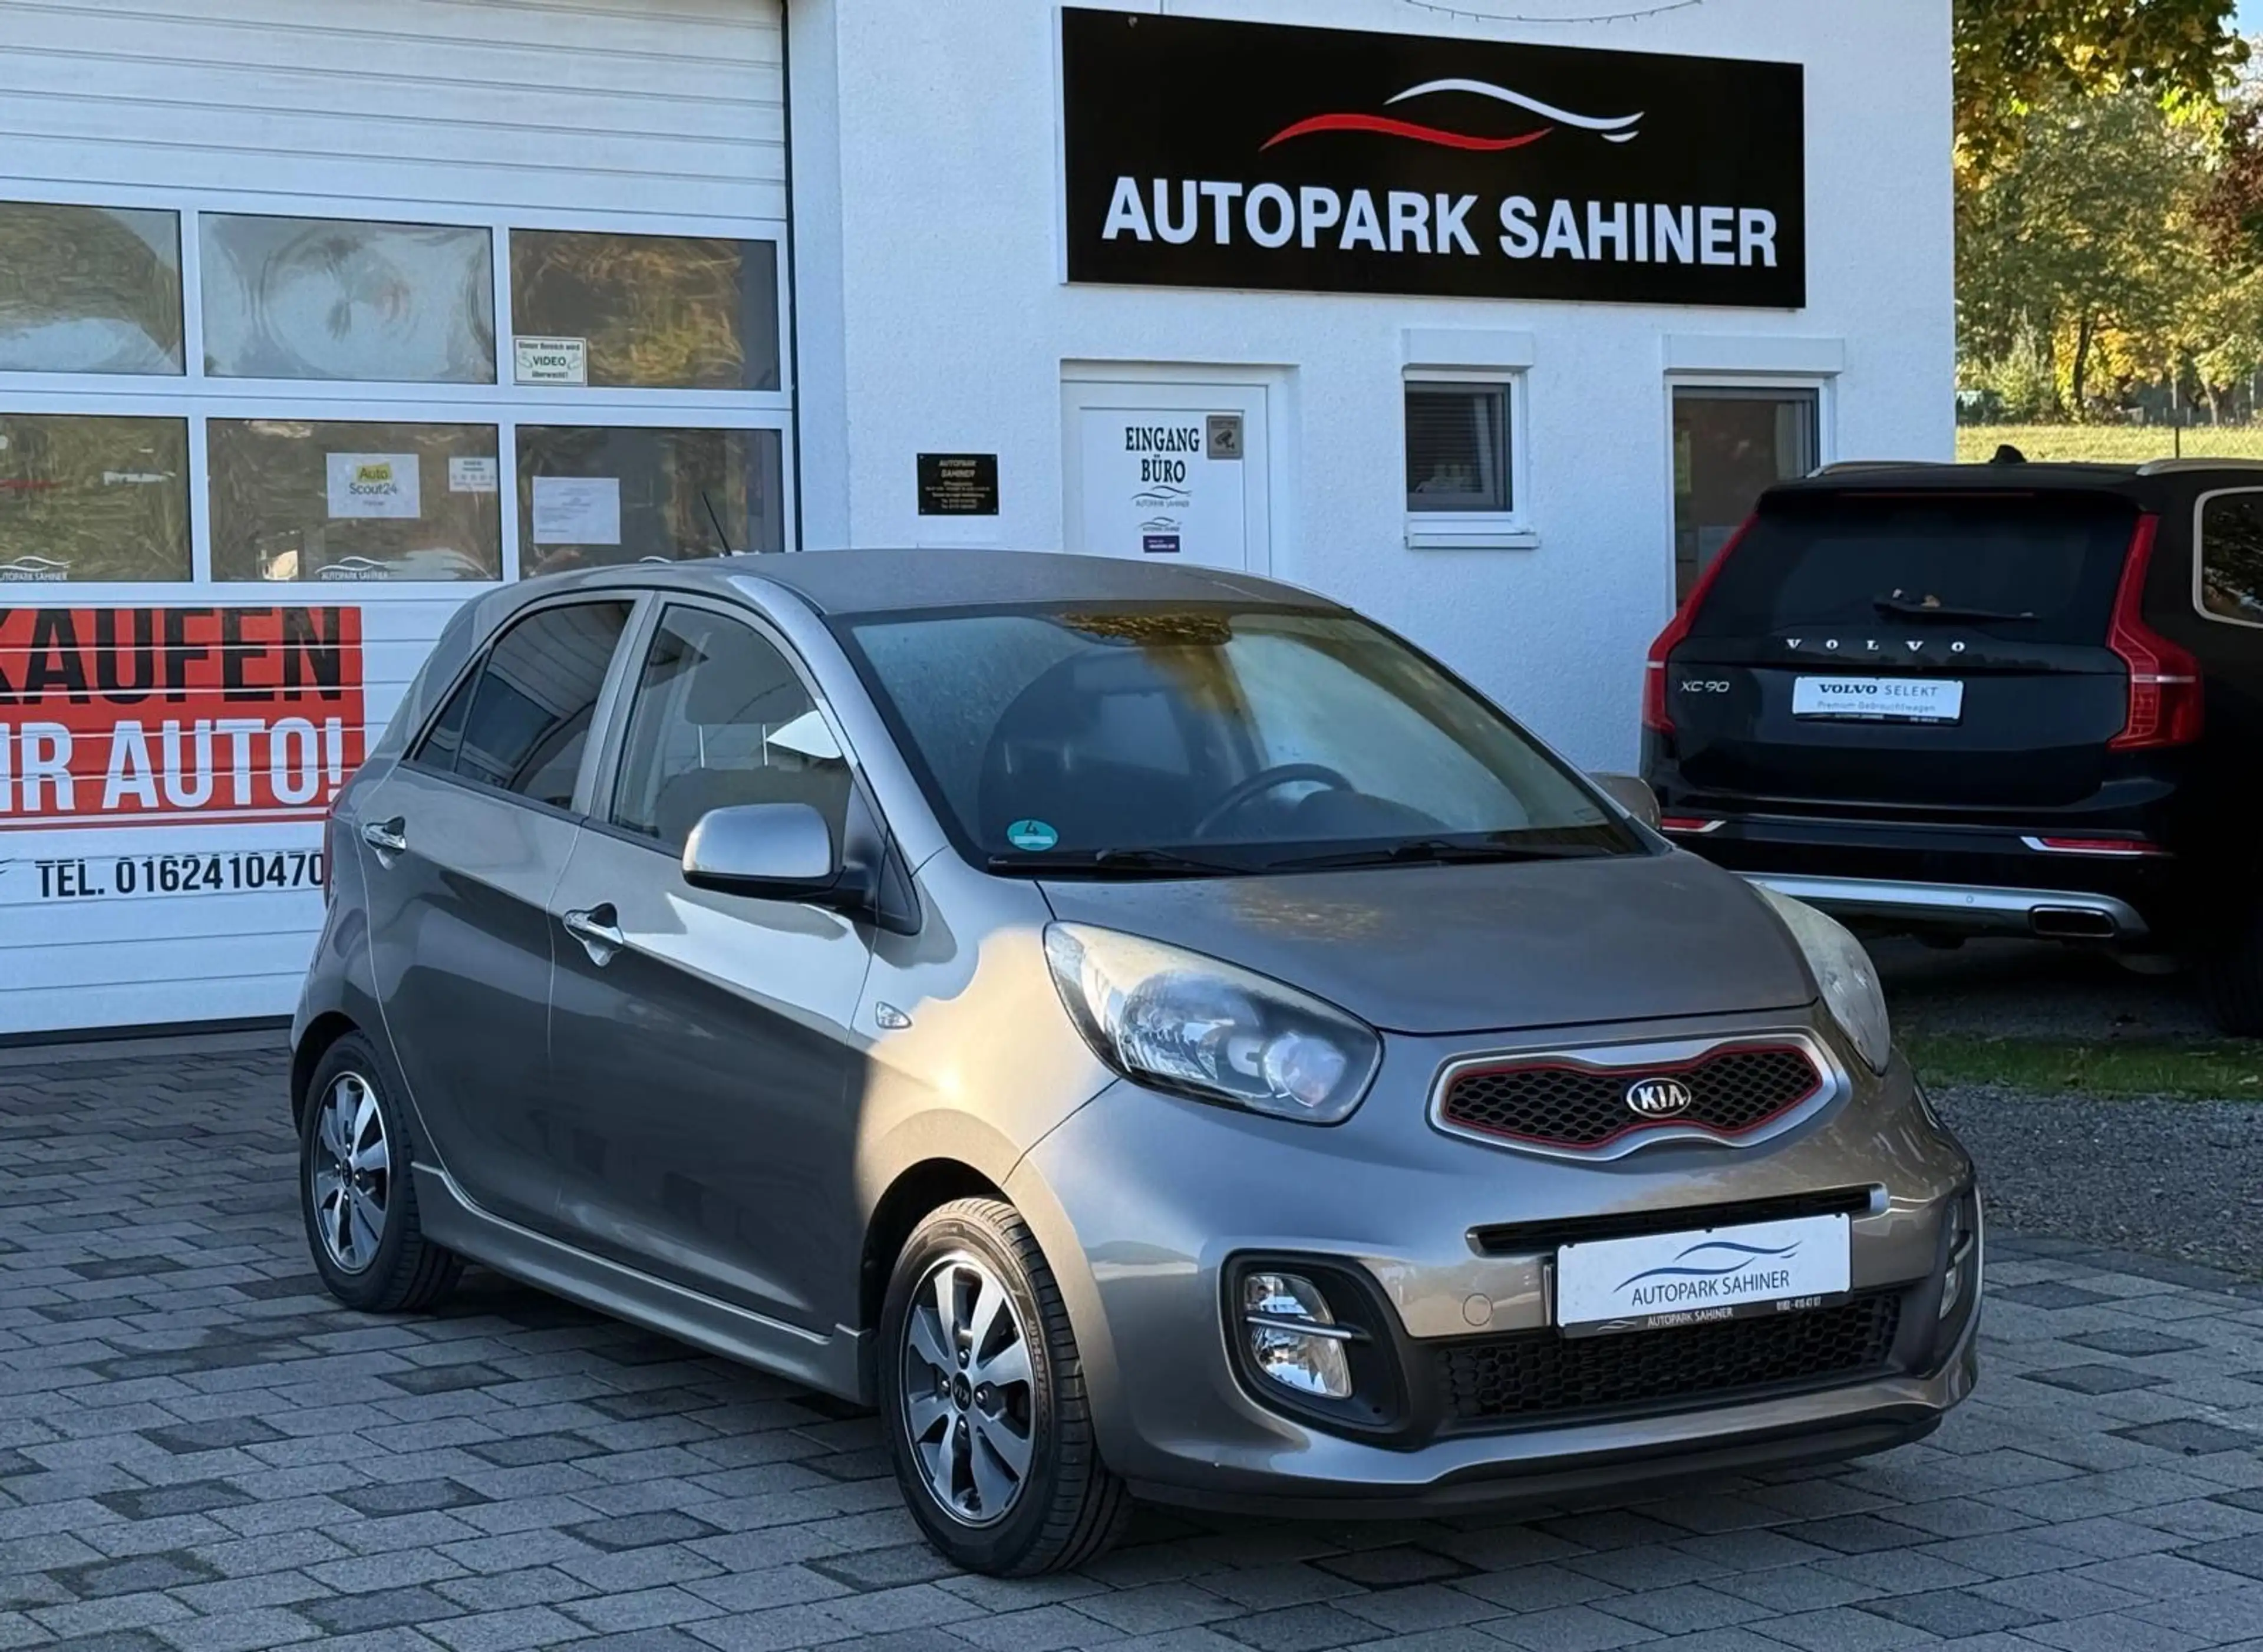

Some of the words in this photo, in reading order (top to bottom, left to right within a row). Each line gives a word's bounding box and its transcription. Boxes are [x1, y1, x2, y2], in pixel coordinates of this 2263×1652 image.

[1102, 177, 1480, 255] AUTOPARK
[1500, 196, 1777, 266] SAHINER
[533, 355, 566, 366] VIDEO
[1126, 427, 1200, 453] EINGANG
[360, 467, 389, 479] Auto
[1142, 454, 1186, 483] BÜRO
[349, 482, 397, 495] Scout24
[1787, 639, 1965, 652] VOLVO
[1680, 680, 1730, 693] XC90
[1819, 684, 1878, 694] VOLVO
[1884, 684, 1939, 697] SELEKT
[102, 717, 343, 810] AUTO!
[1024, 822, 1040, 835] 4
[35, 859, 105, 897] TEL.
[1638, 1084, 1686, 1110] KIA
[1632, 1278, 1718, 1306] AUTOPARK
[1722, 1269, 1789, 1296] SAHINER
[1648, 1313, 1693, 1327] AUTOPARK
[1695, 1307, 1733, 1322] SAHINER
